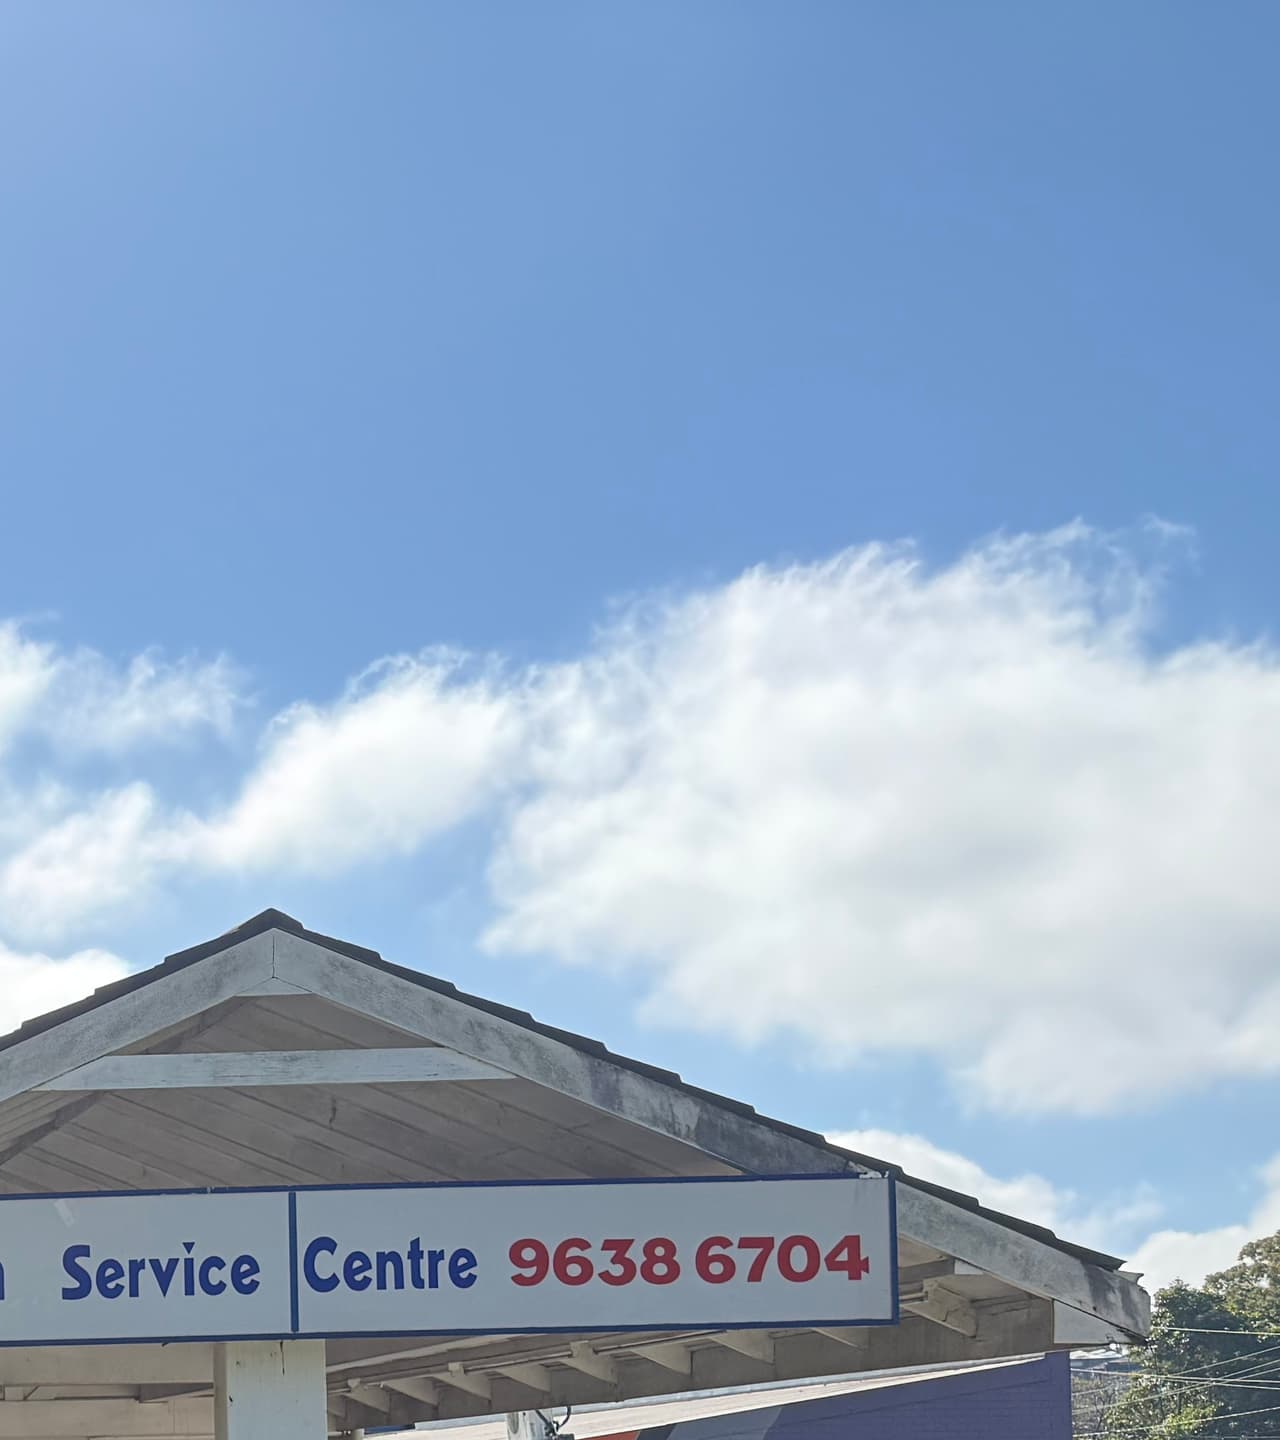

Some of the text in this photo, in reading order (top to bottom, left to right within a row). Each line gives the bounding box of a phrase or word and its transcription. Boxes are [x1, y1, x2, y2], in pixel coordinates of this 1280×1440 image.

[62, 1241, 260, 1300] Service
[304, 1236, 478, 1292] Centre
[508, 1237, 681, 1287] 9638
[695, 1235, 870, 1285] 6704
